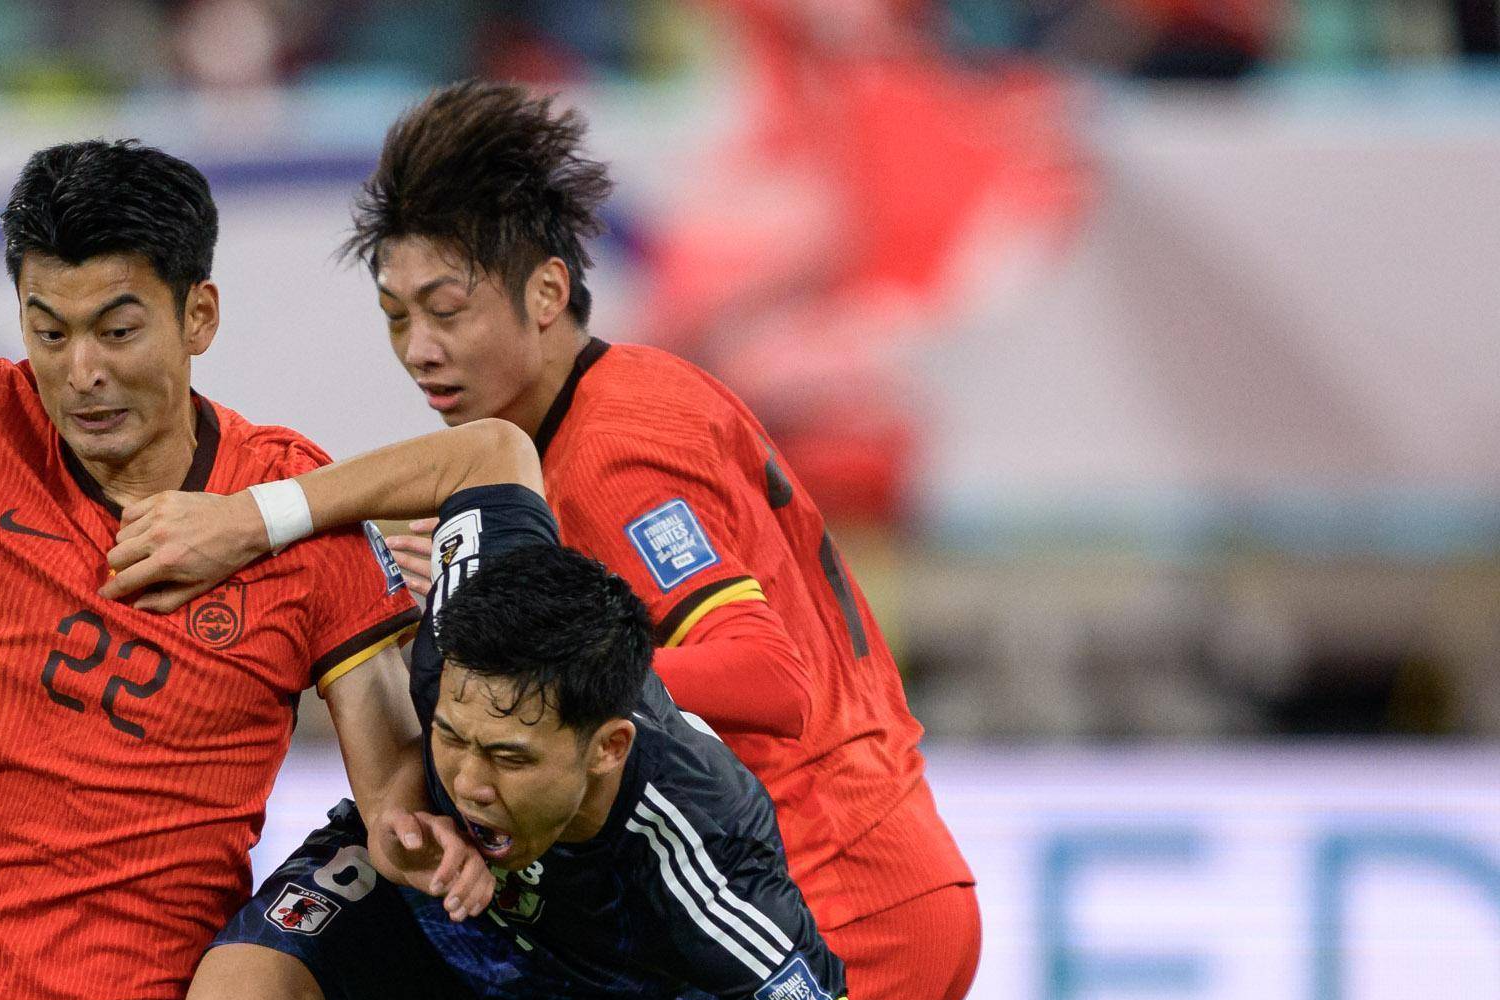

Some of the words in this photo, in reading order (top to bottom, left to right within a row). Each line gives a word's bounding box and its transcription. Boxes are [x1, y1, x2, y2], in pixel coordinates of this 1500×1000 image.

[650, 523, 689, 551] UNITES
[40, 608, 173, 740] 22
[298, 889, 328, 904] JAPAN
